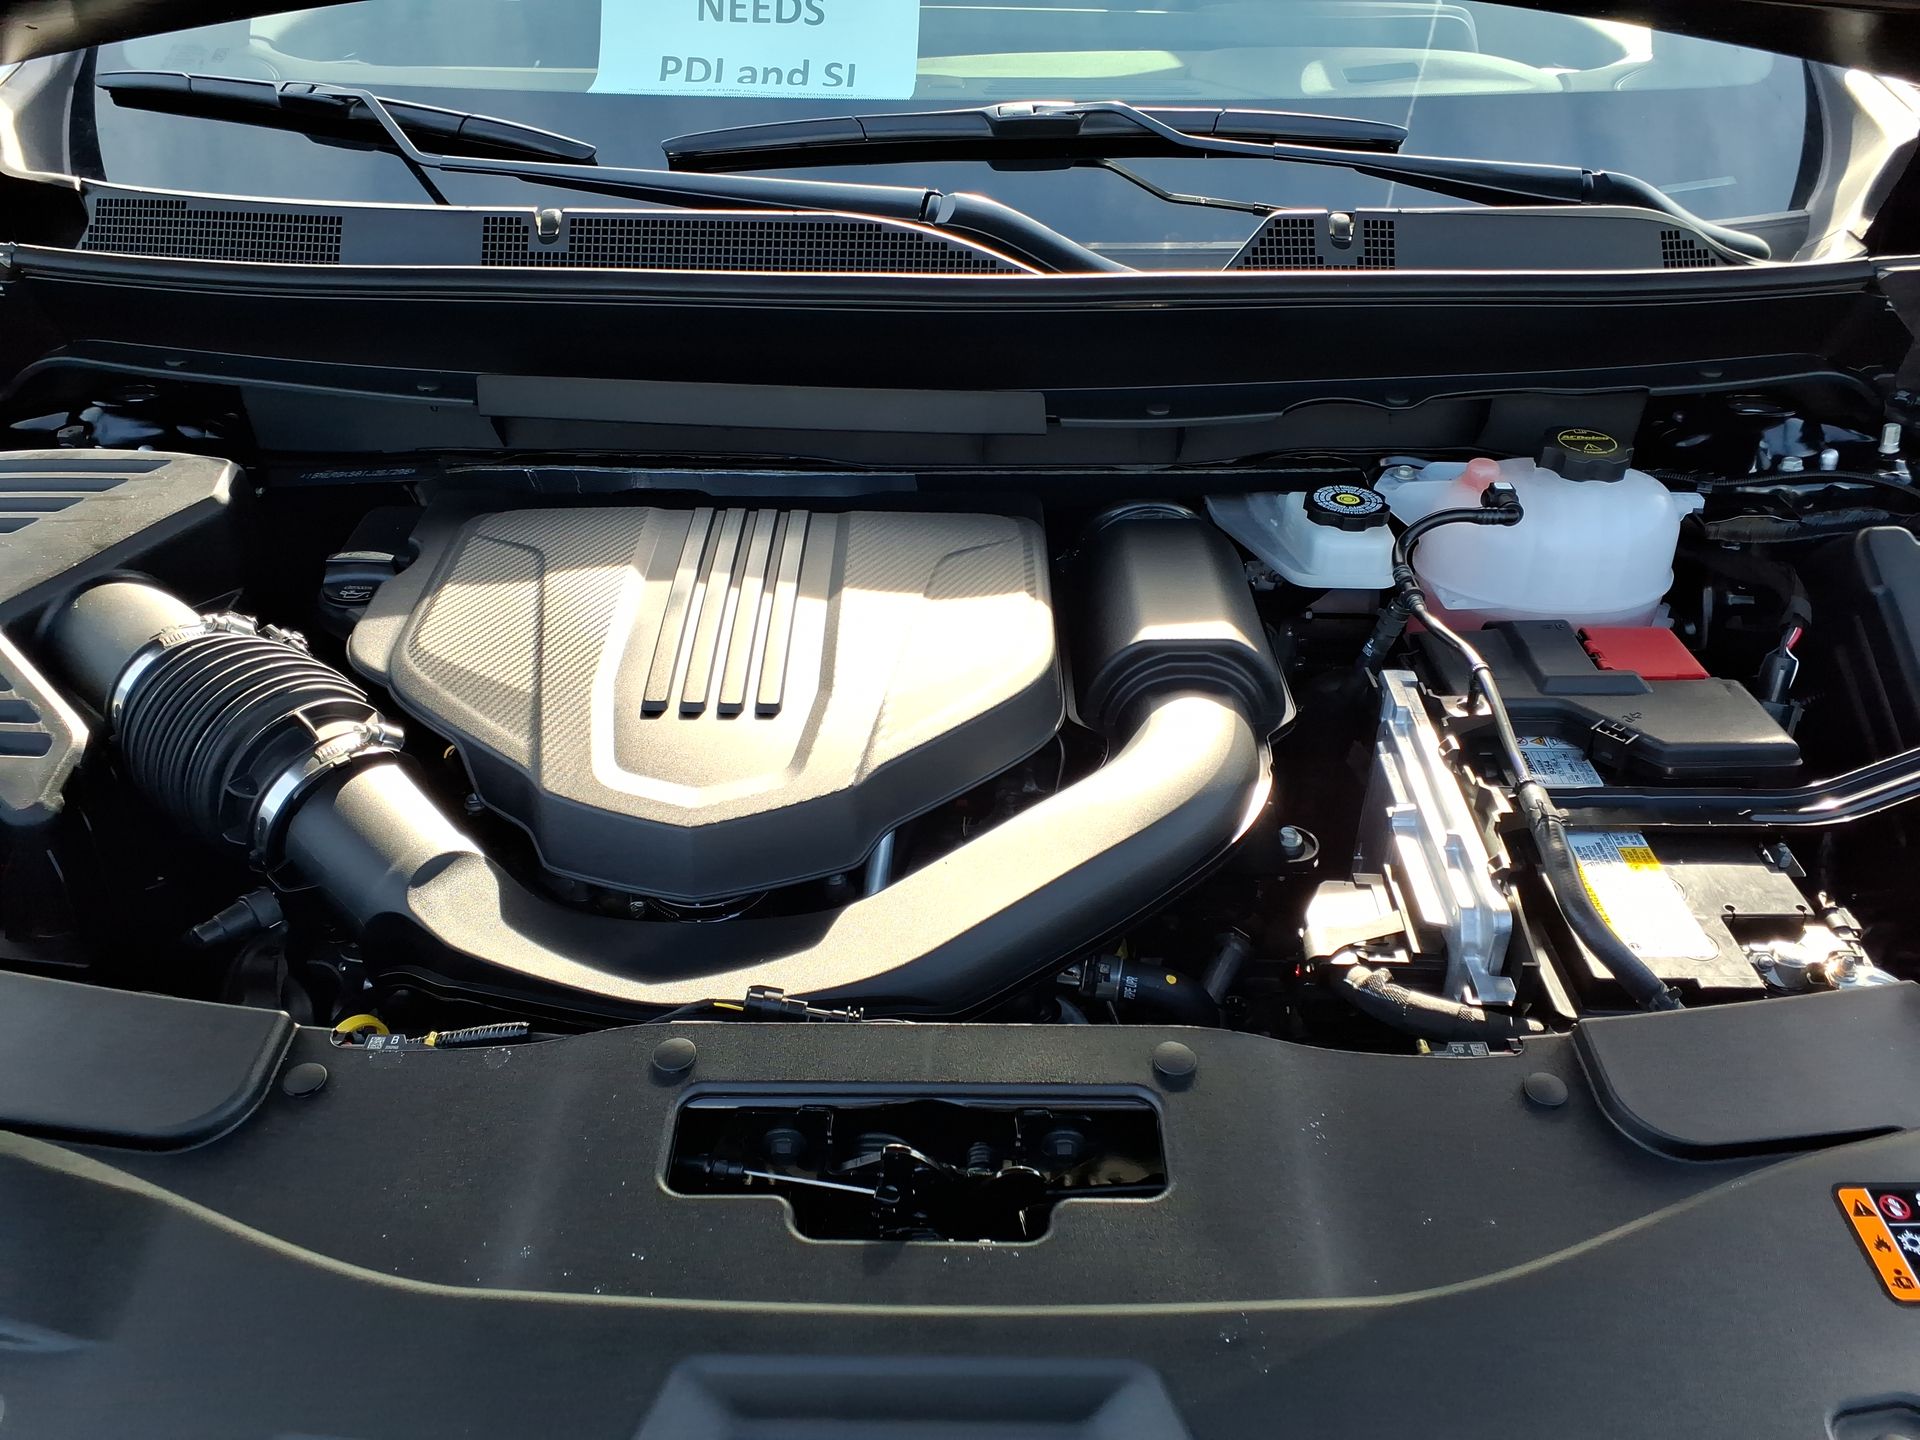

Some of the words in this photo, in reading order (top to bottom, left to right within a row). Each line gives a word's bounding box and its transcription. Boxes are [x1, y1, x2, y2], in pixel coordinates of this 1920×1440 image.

[698, 0, 825, 25] NEEDS
[659, 55, 724, 84] PDI
[736, 59, 810, 86] and
[822, 62, 856, 88] SI
